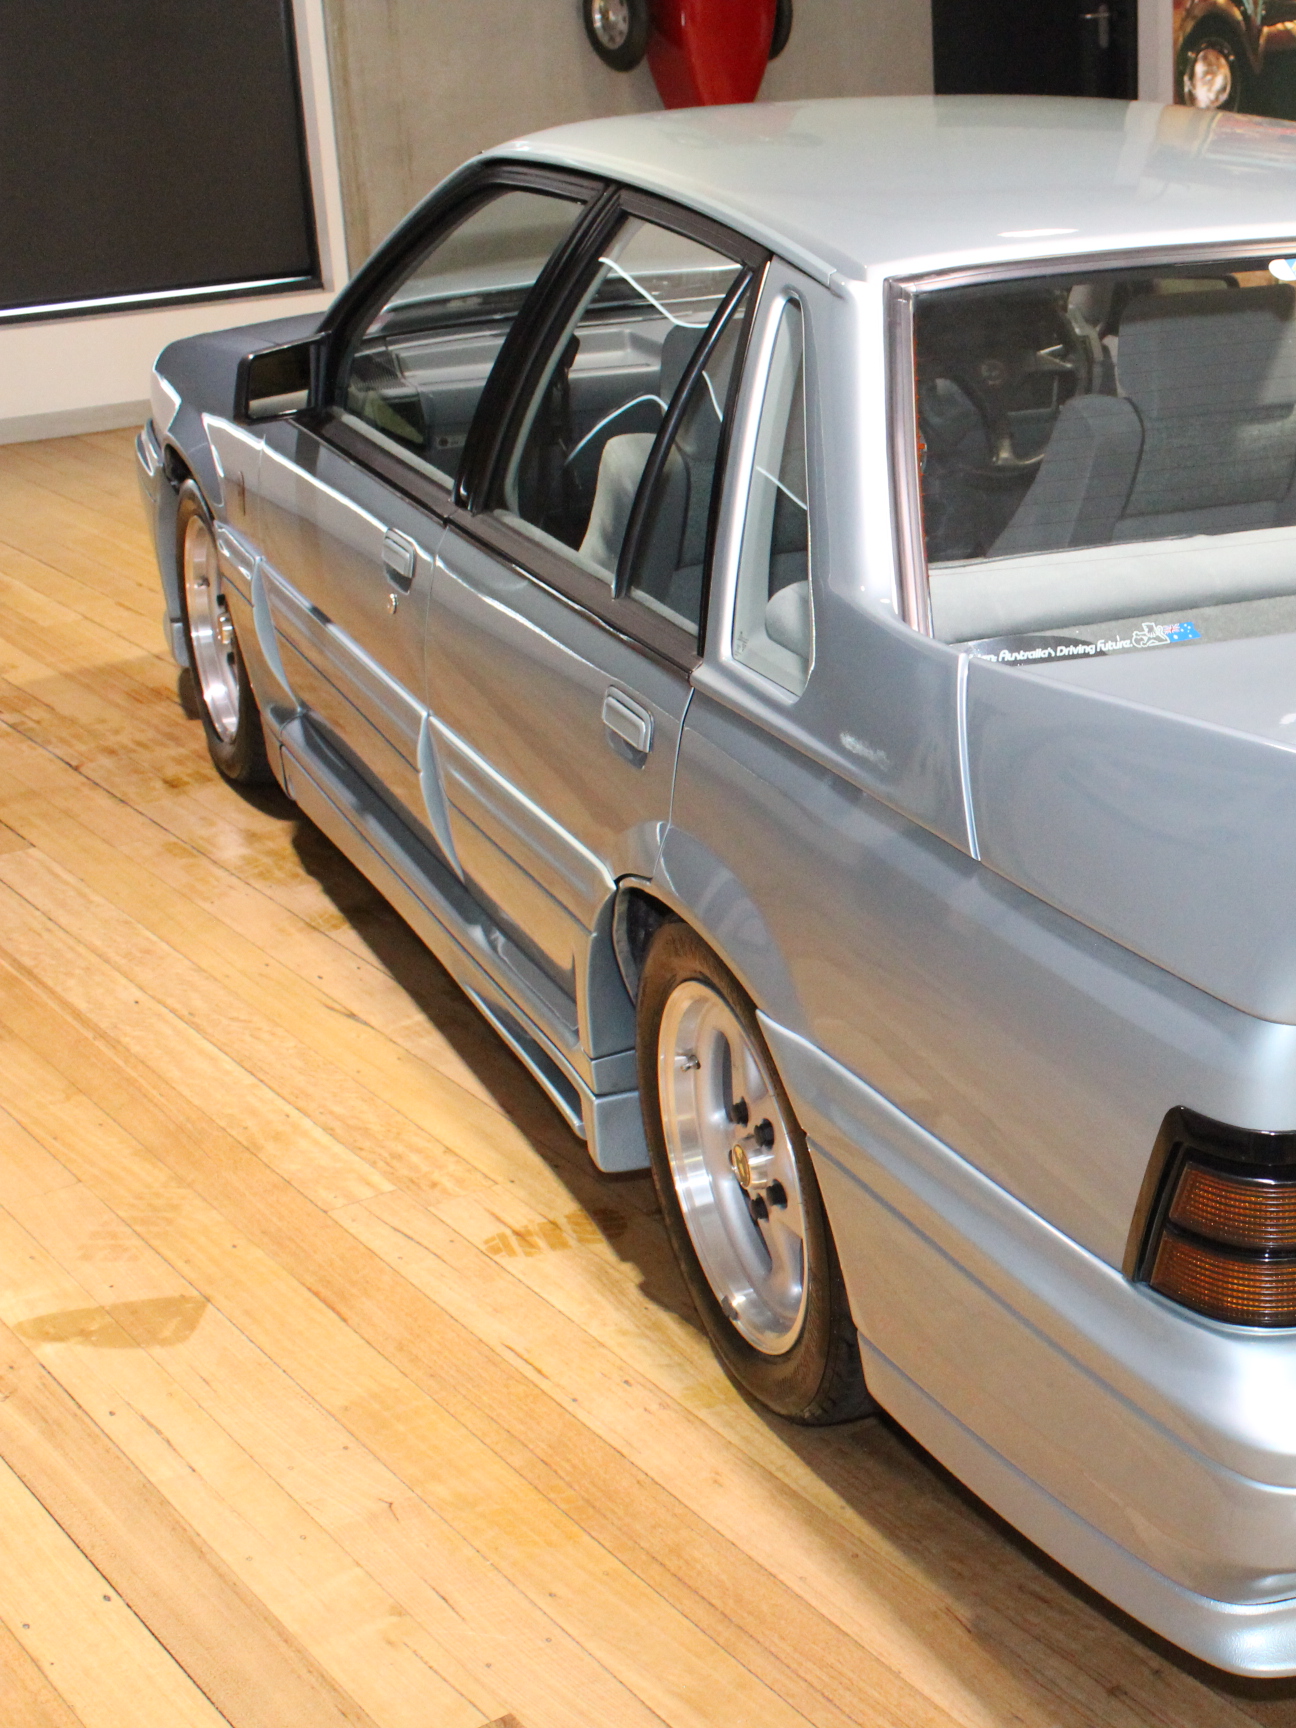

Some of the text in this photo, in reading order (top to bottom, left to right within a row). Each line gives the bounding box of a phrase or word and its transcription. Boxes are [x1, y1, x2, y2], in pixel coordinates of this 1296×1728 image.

[999, 648, 1055, 663] Australia's
[1056, 642, 1096, 657] Driving
[1096, 635, 1133, 653] Future.
